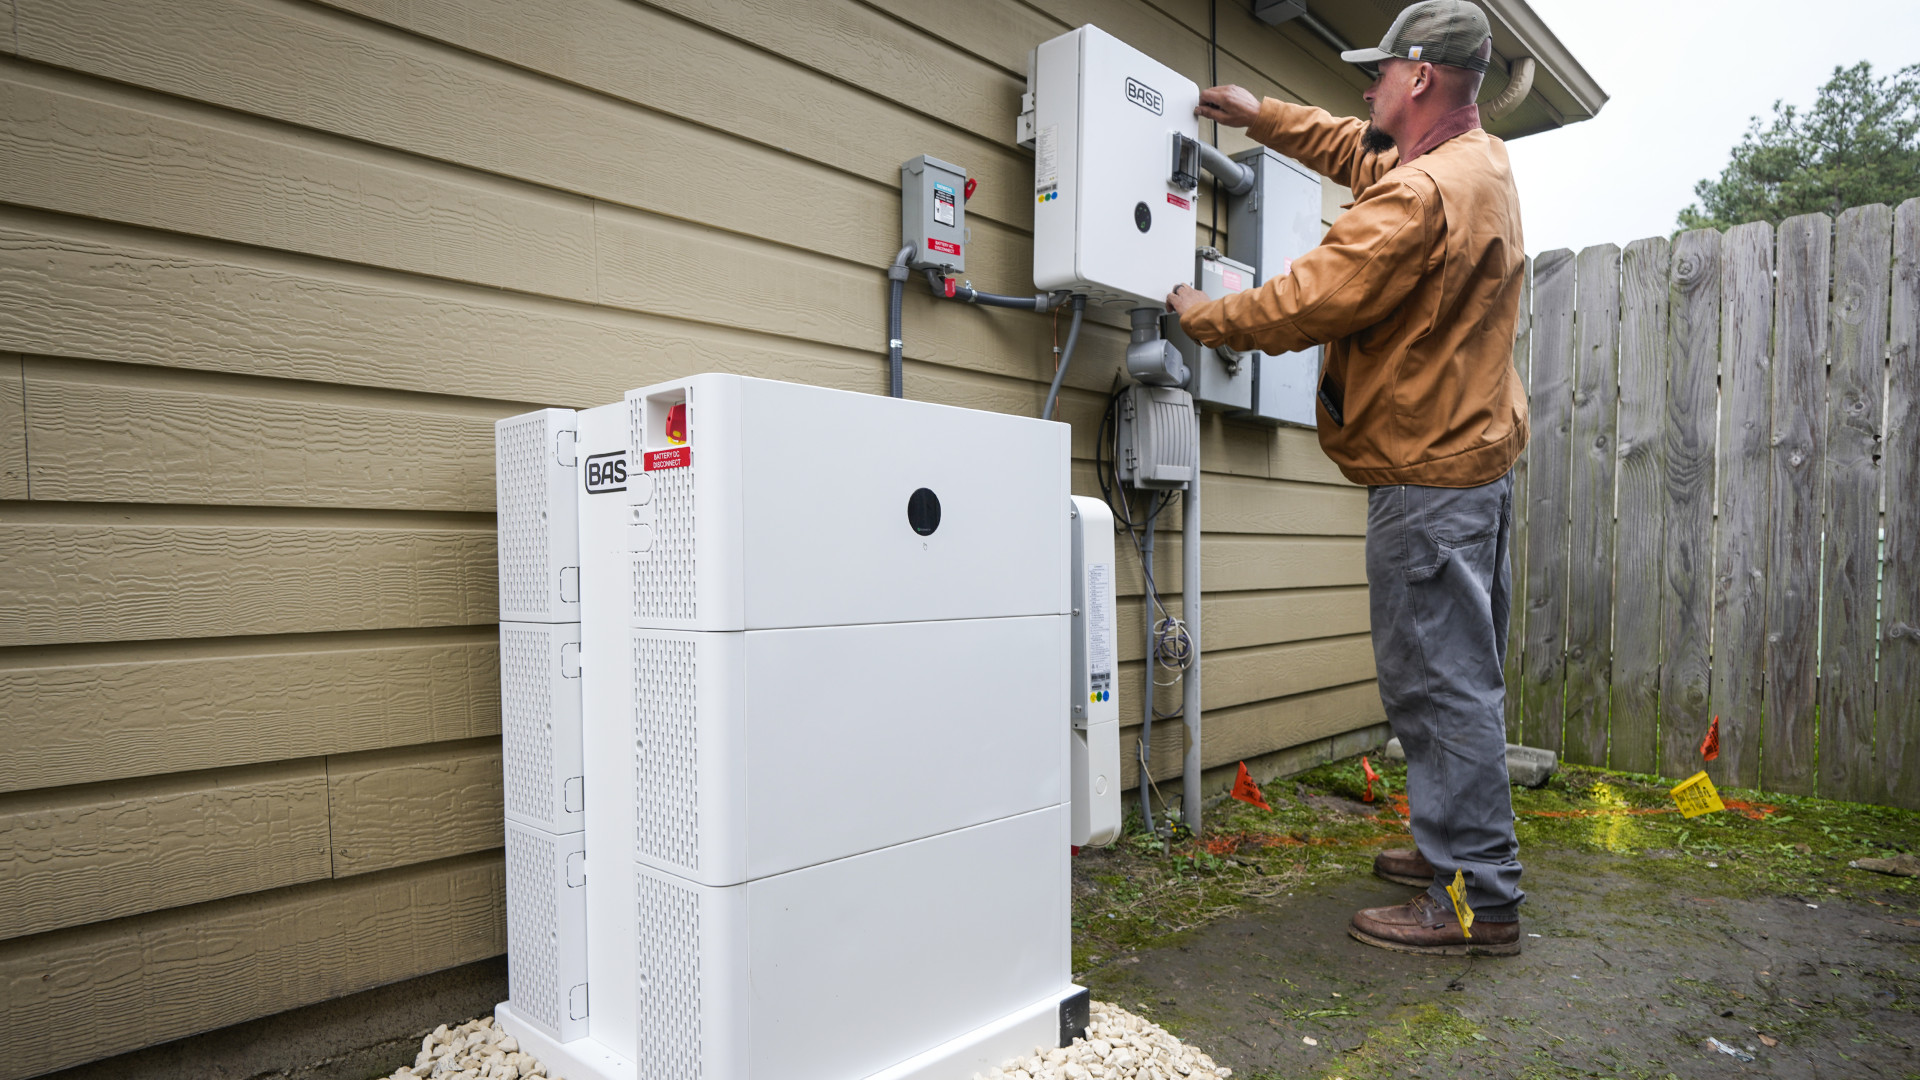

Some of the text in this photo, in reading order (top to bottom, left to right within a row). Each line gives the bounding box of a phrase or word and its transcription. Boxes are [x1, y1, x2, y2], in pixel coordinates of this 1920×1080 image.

[1128, 82, 1161, 111] BASE
[652, 459, 682, 469] DISCONNECT
[653, 450, 681, 461] BATTERY DC
[588, 459, 627, 486] BAS
